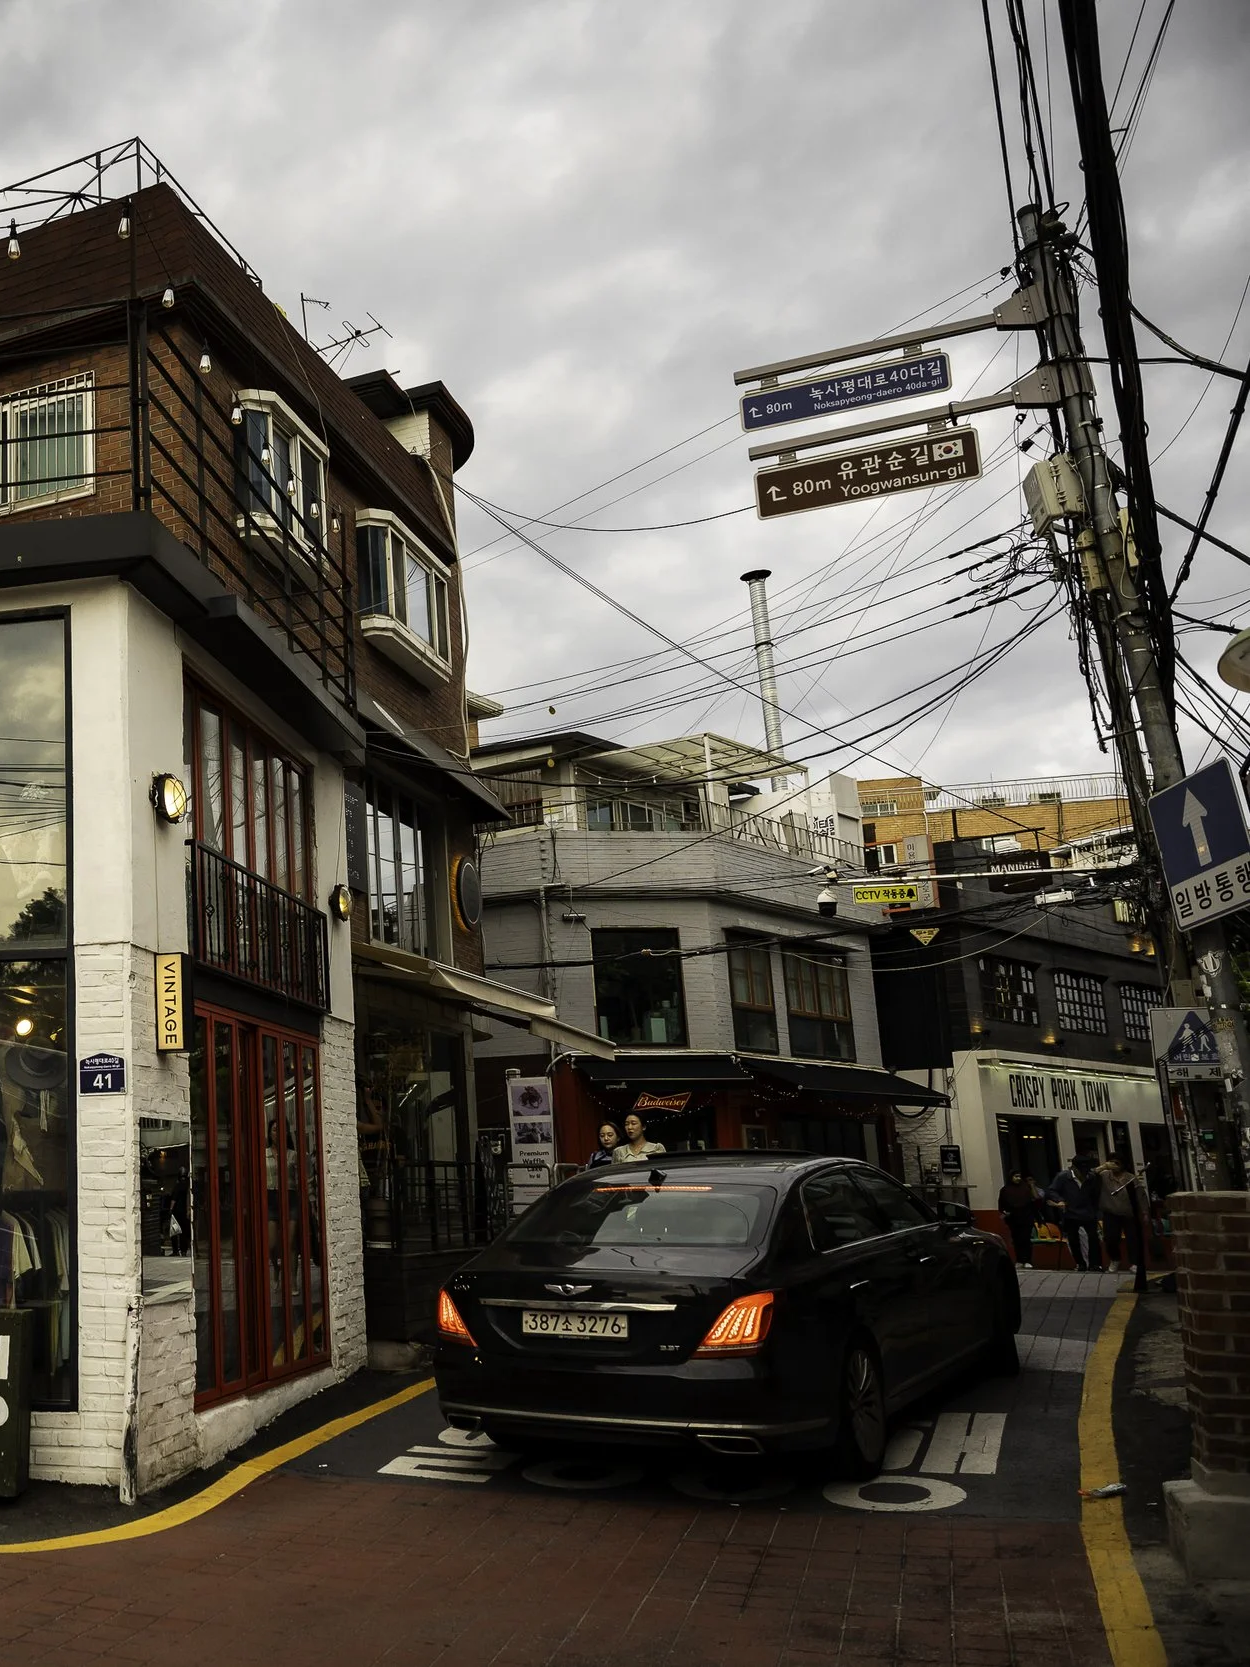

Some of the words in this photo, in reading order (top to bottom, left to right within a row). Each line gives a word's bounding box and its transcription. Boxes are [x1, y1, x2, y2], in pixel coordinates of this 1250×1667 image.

[808, 360, 942, 400] 녹사평대로40다길
[813, 386, 902, 411] Noksapyeong-daero
[905, 376, 943, 391] 40da-gil
[766, 401, 793, 414] 80m
[837, 444, 930, 481] 유관순길
[840, 461, 966, 498] Yoogwansun-gil
[792, 478, 832, 496] 80m
[856, 890, 880, 900] CCTV
[882, 888, 906, 899] 작동중
[163, 961, 178, 1045] VINTAGE
[92, 1073, 112, 1090] 41
[1009, 1074, 1046, 1108] CRISPY
[1050, 1077, 1079, 1111] PORK
[1081, 1081, 1112, 1113] TOWN
[637, 1096, 687, 1107] Budweiser
